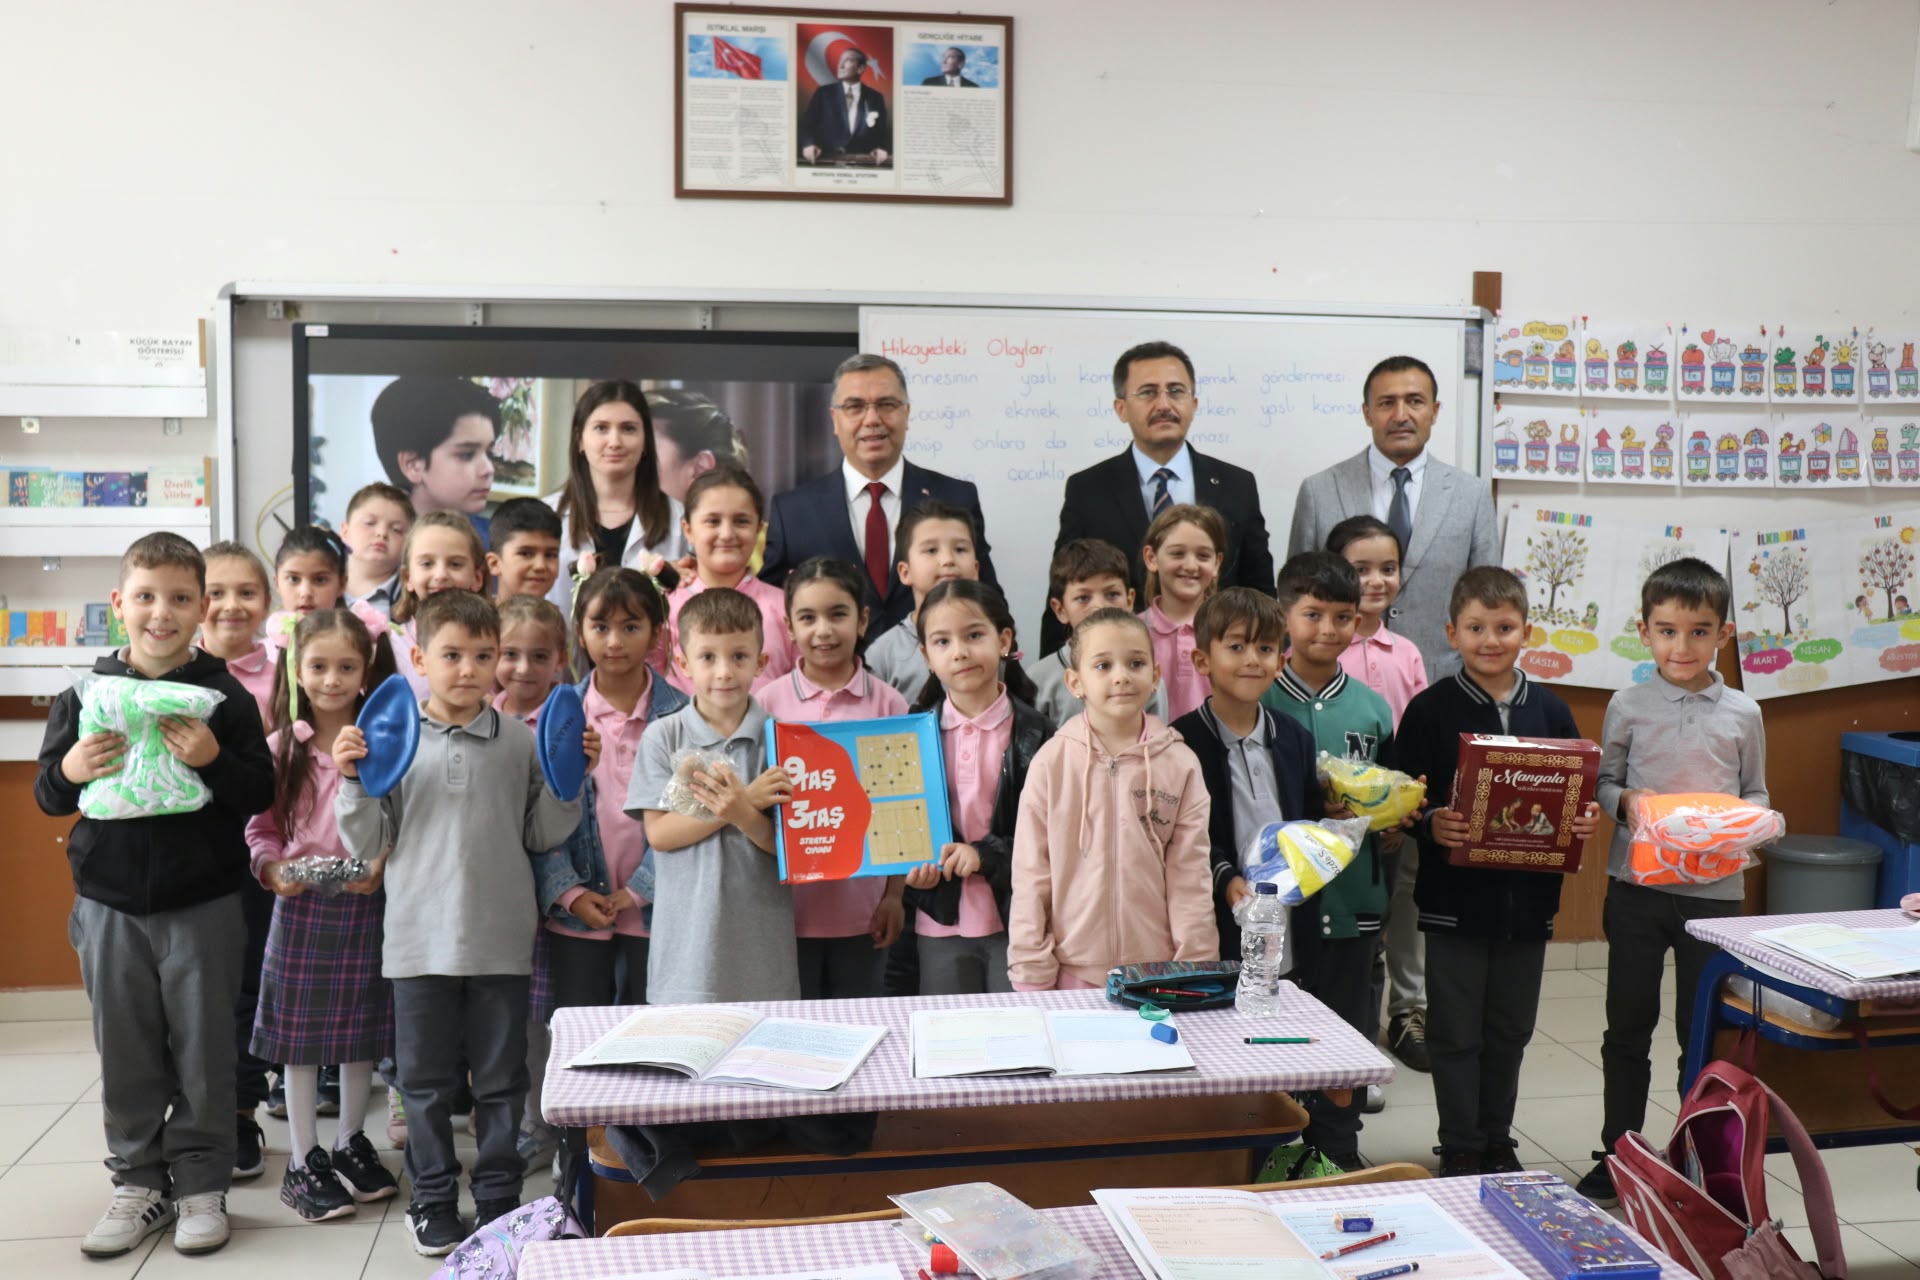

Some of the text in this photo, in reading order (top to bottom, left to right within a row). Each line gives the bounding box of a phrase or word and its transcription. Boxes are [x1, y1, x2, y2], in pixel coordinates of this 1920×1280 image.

[162, 338, 192, 347] BAYAN
[881, 340, 967, 364] Hikayedeki
[1079, 365, 1113, 384] kom
[910, 404, 970, 427] ocuğun
[1004, 401, 1059, 419] ekmek
[904, 437, 943, 456] ünüp
[1045, 432, 1067, 450] da
[1094, 431, 1134, 449] ekm
[1192, 432, 1230, 444] ması
[1536, 509, 1592, 527] SONBAHAR
[1874, 516, 1892, 529] YAZ
[1665, 525, 1683, 541] KIŞ
[1757, 528, 1806, 546] İLKBAHAR
[1529, 656, 1560, 669] KASIM
[1753, 655, 1779, 666] MART
[1345, 731, 1377, 761] N
[1494, 769, 1567, 787] Mangala
